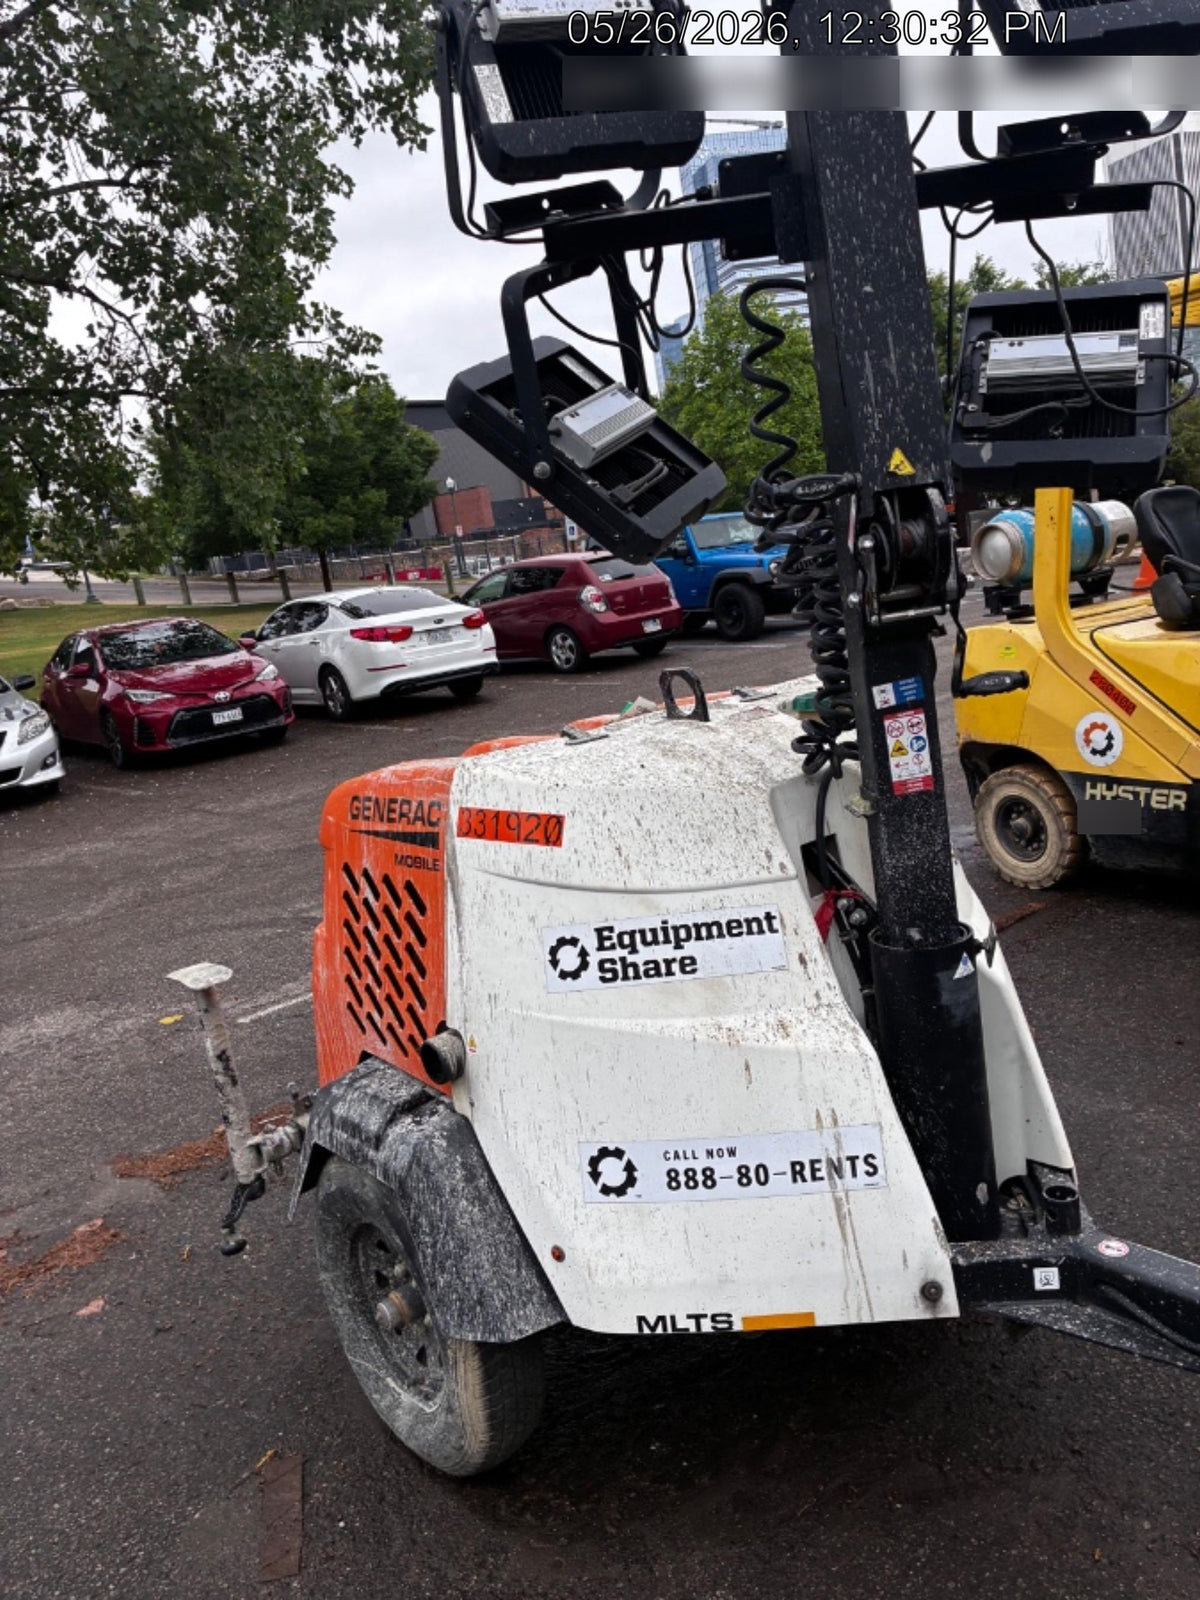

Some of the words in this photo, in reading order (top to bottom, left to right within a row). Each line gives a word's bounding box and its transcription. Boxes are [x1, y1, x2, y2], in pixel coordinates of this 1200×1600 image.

[349, 795, 441, 827] GENERAC
[1085, 781, 1188, 811] HYSTER
[459, 807, 563, 847] 331920
[394, 853, 440, 871] MOBILE
[594, 911, 779, 955] Equipment
[598, 955, 698, 984] Share
[663, 1149, 699, 1161] CALL
[705, 1146, 738, 1159] NOW
[666, 1153, 879, 1191] 888-80-RENTS
[636, 1313, 734, 1333] MLTS
